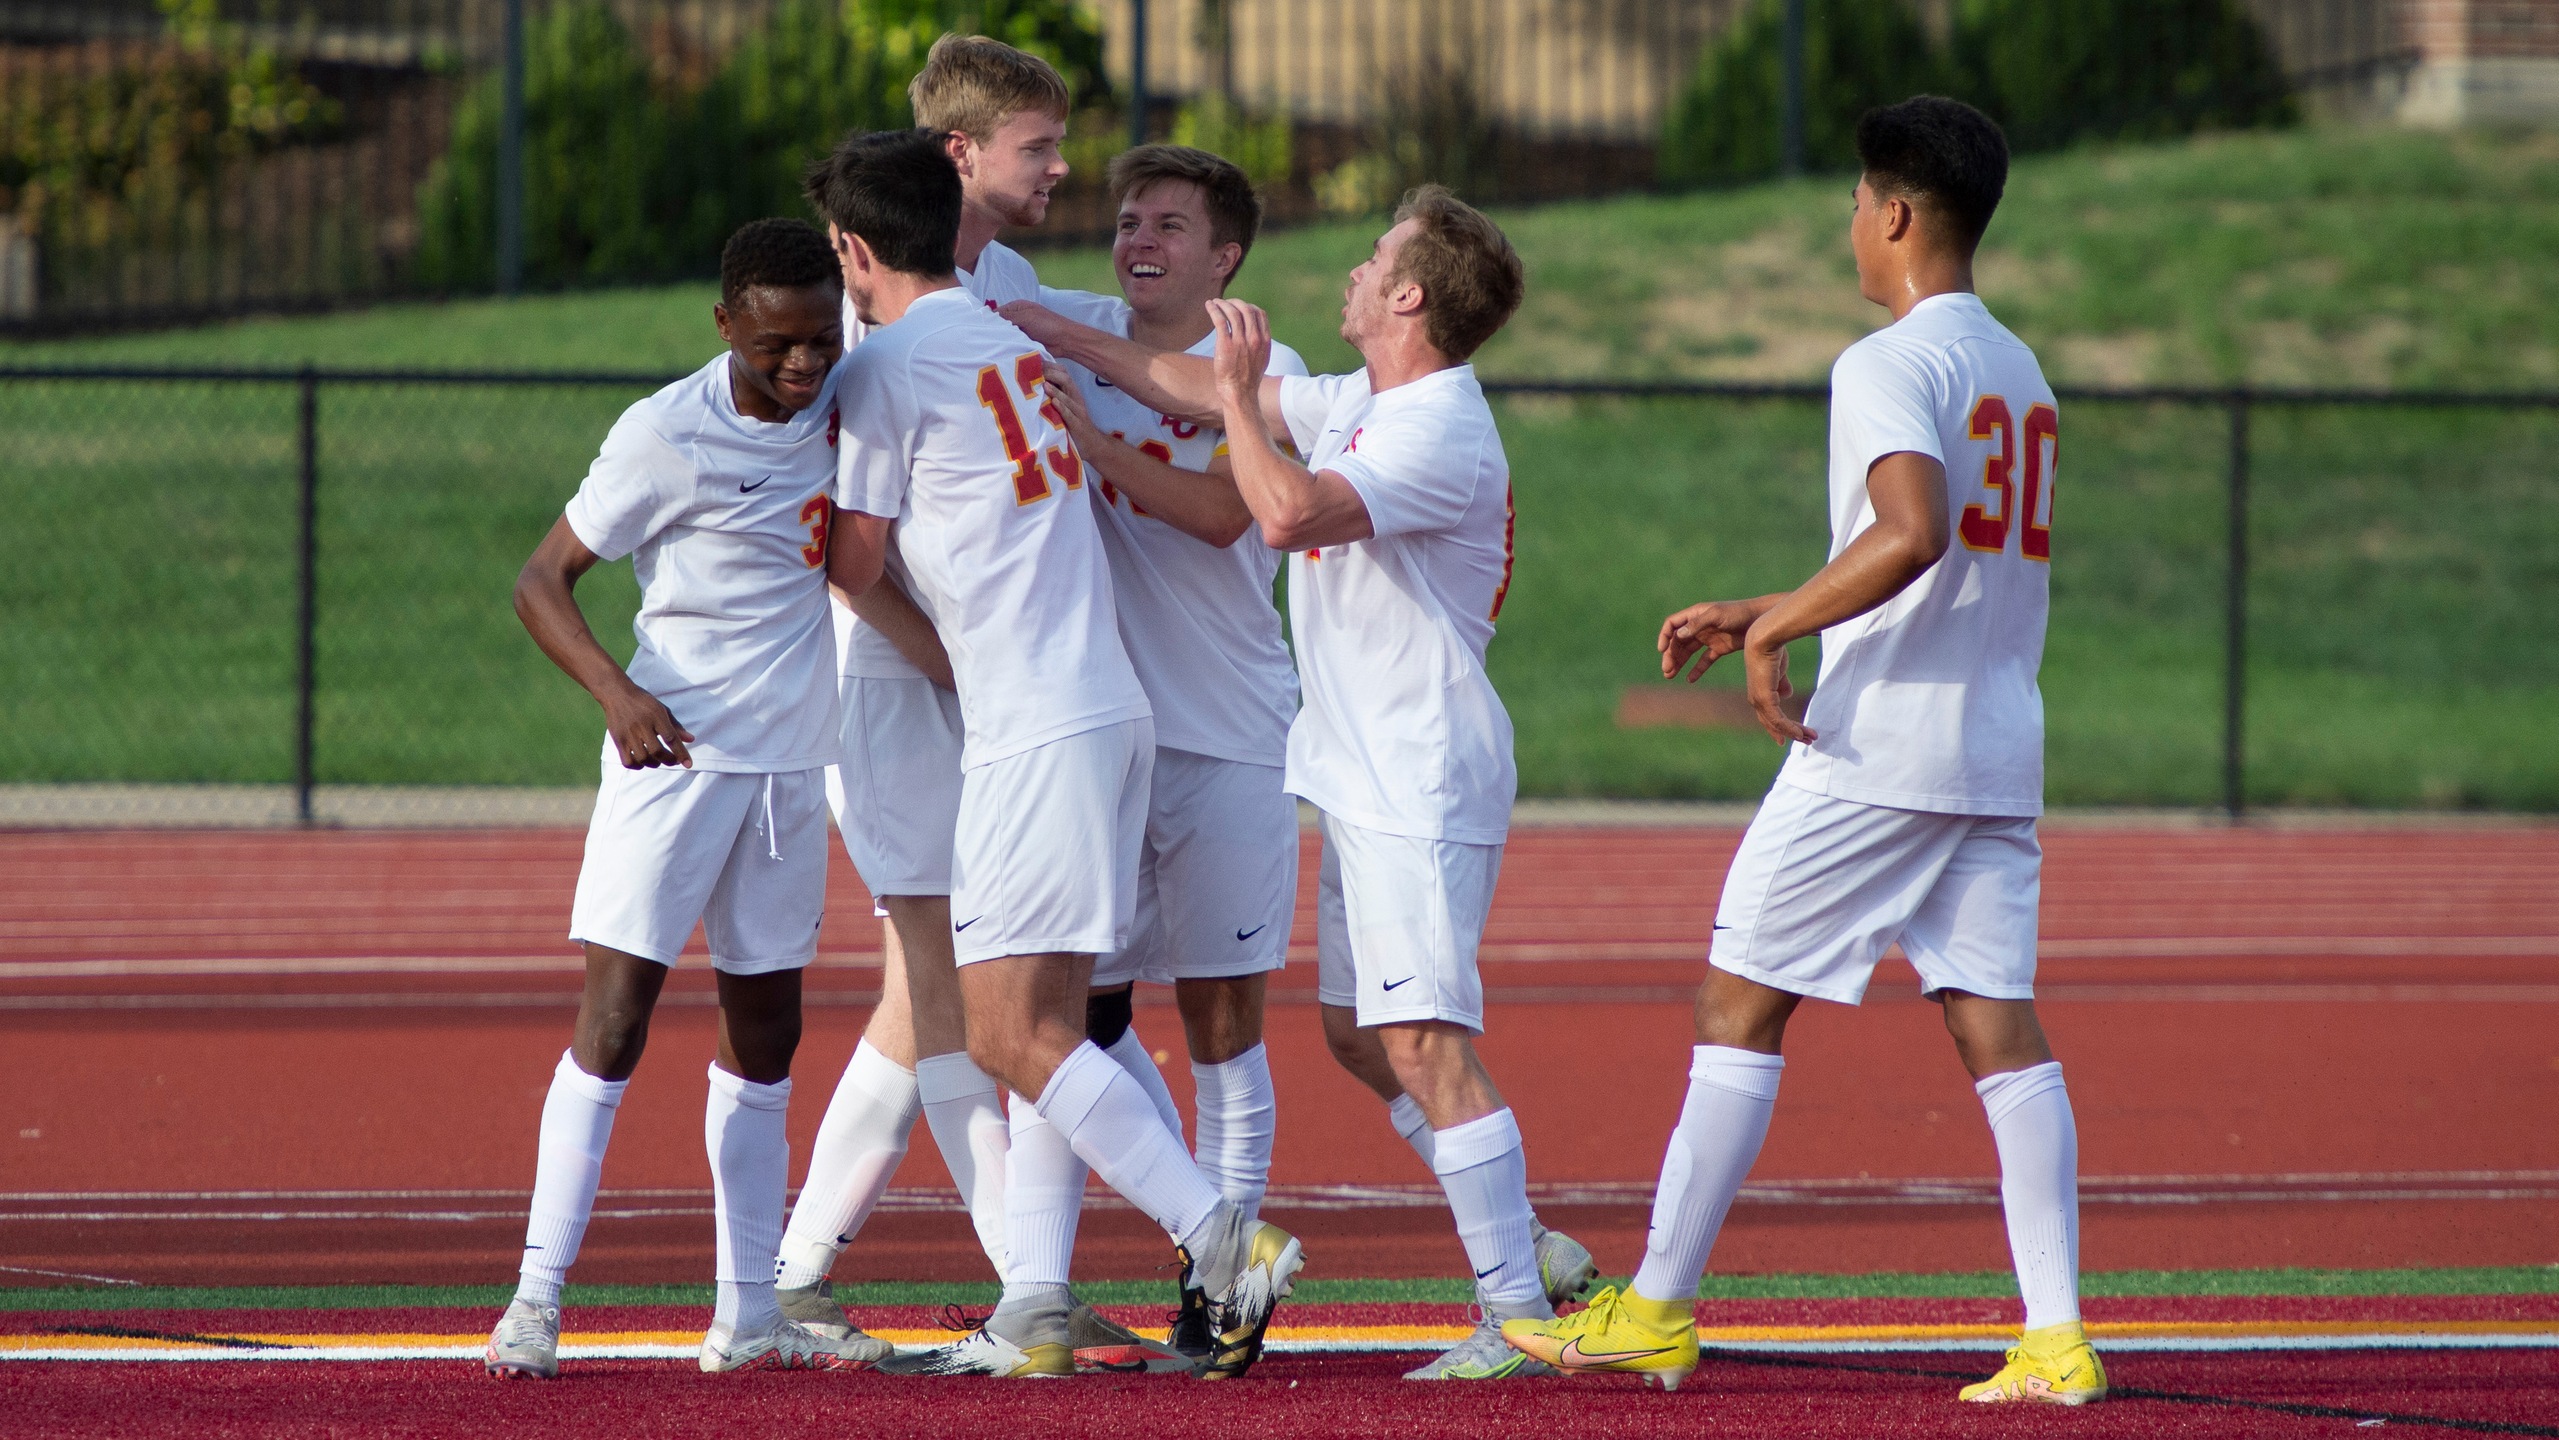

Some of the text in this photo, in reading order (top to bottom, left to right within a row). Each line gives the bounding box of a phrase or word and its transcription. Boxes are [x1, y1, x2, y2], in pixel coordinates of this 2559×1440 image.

[976, 350, 1082, 507] 13
[1958, 394, 2059, 562] 30
[800, 492, 831, 569] 3
